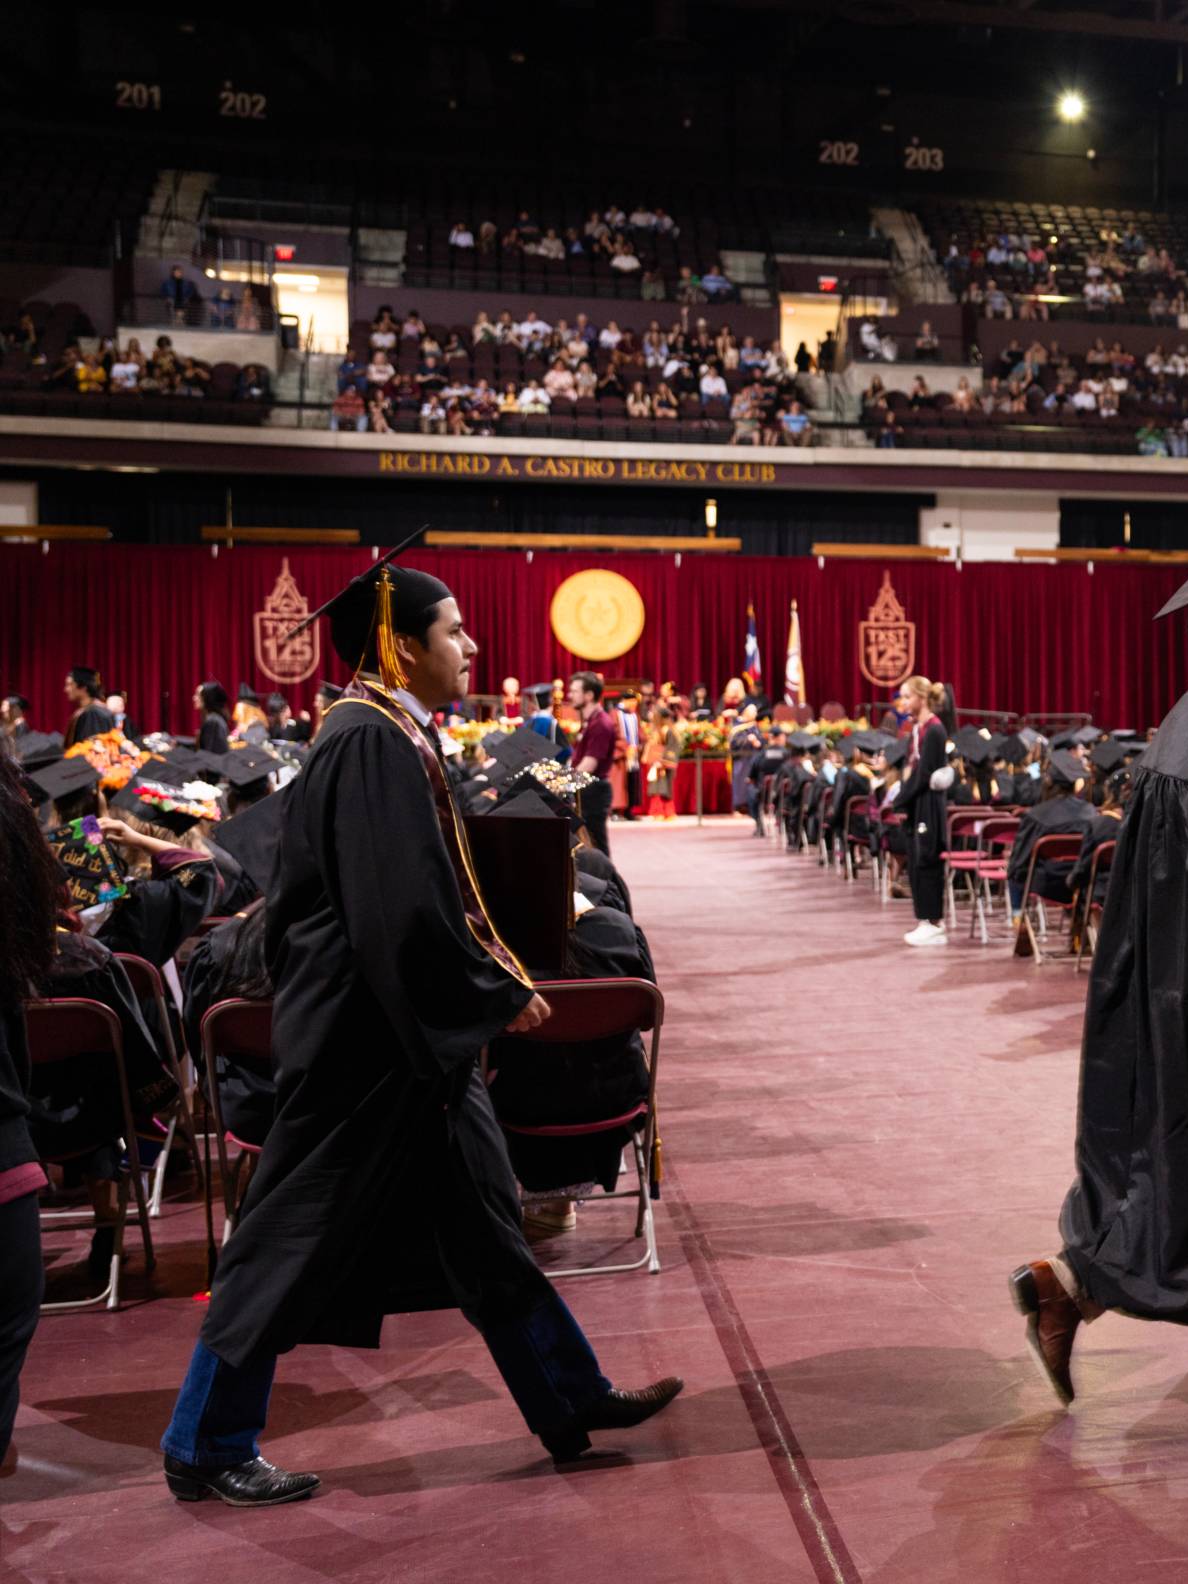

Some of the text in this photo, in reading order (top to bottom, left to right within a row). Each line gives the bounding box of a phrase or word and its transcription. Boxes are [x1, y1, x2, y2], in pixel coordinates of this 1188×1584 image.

[115, 80, 161, 112] 201
[219, 92, 267, 119] 202
[819, 140, 859, 166] 202
[904, 147, 944, 171] 203
[379, 452, 776, 482] RICHARD A. CASTRO LEGACY CLUB
[263, 636, 313, 661] 125
[866, 643, 909, 667] 125
[63, 848, 87, 868] did
[88, 858, 102, 873] it
